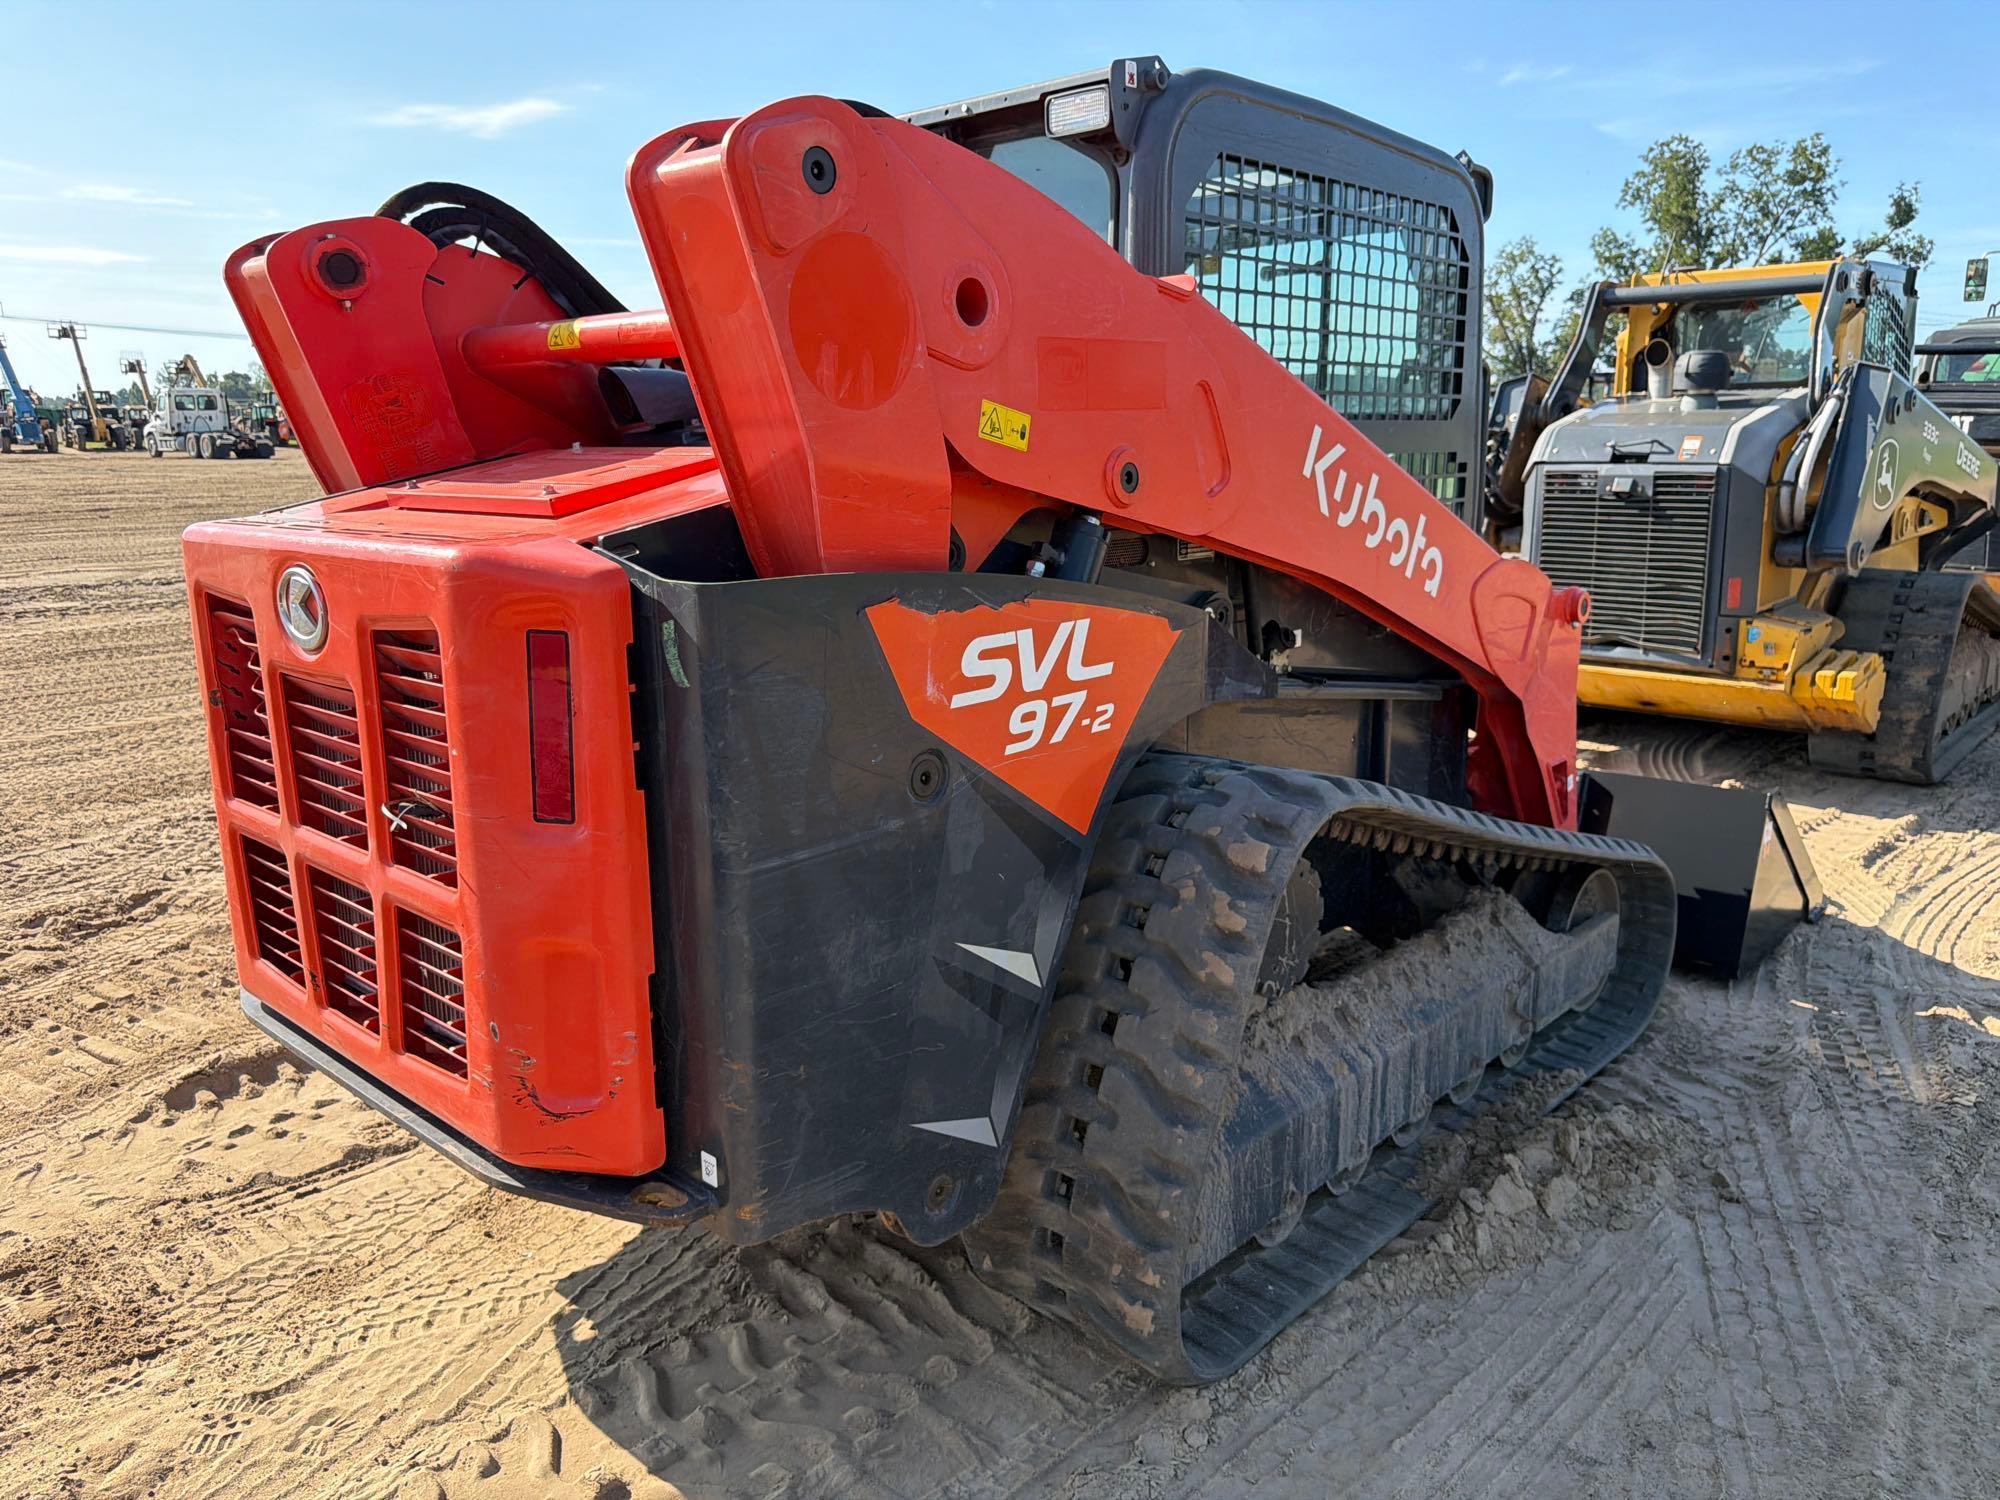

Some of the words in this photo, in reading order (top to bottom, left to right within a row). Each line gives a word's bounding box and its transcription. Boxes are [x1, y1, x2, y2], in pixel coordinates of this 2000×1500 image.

[1956, 440, 1981, 480] DEERE
[1303, 424, 1443, 598] Kubota
[950, 618, 1114, 709] SVL
[1004, 690, 1115, 756] 97-2
